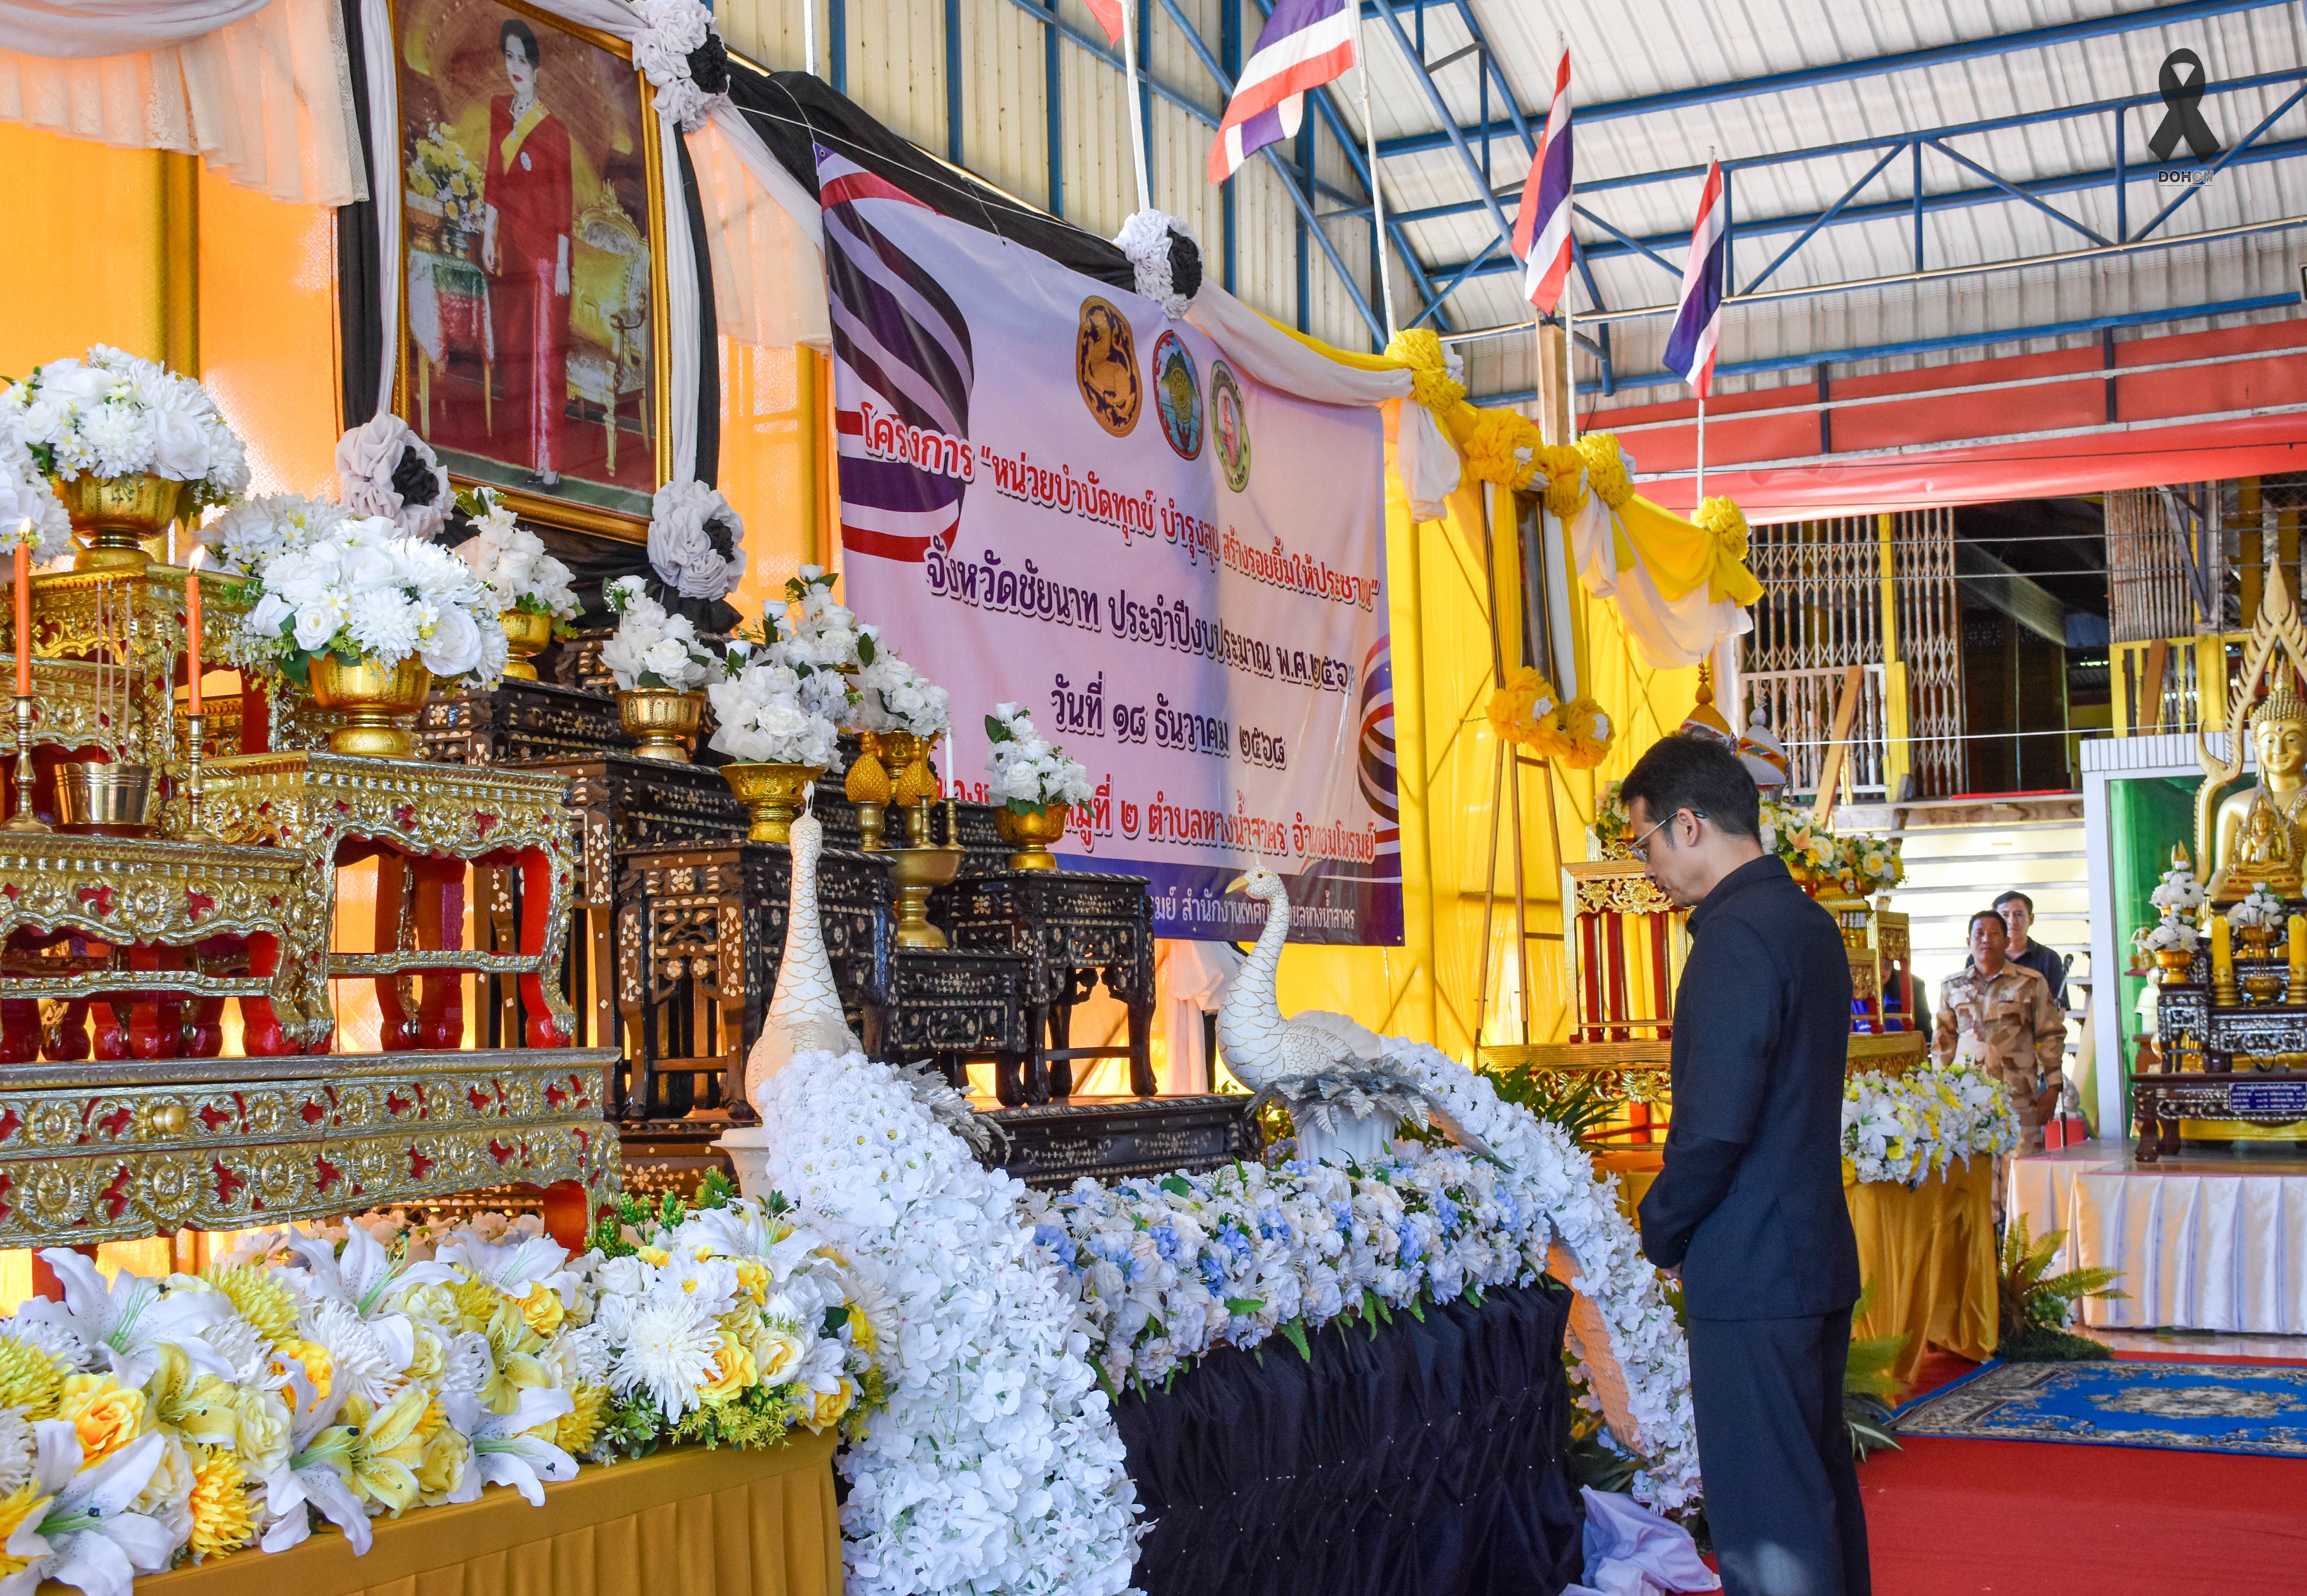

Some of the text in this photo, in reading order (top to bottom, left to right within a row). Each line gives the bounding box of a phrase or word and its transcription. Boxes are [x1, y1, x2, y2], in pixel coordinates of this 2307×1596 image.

[861, 402, 972, 476] โครงการ
[981, 446, 1154, 538] "หน่วยบำบัดทุกข์
[1161, 498, 1219, 566] บำรุงสุข
[927, 534, 1354, 689] จังหวัดชัยนาท ประจำปีงบประมาณ พ.ศ.๒๕๖
[1052, 671, 1285, 764] วันที่ ๑๘ ธันวาคม ๒๕๖๘
[1121, 800, 1138, 832] ๒
[1149, 790, 1286, 850] ตำบลหางน้ำสาคร
[1292, 812, 1374, 860] อำเภอมโนรมย์
